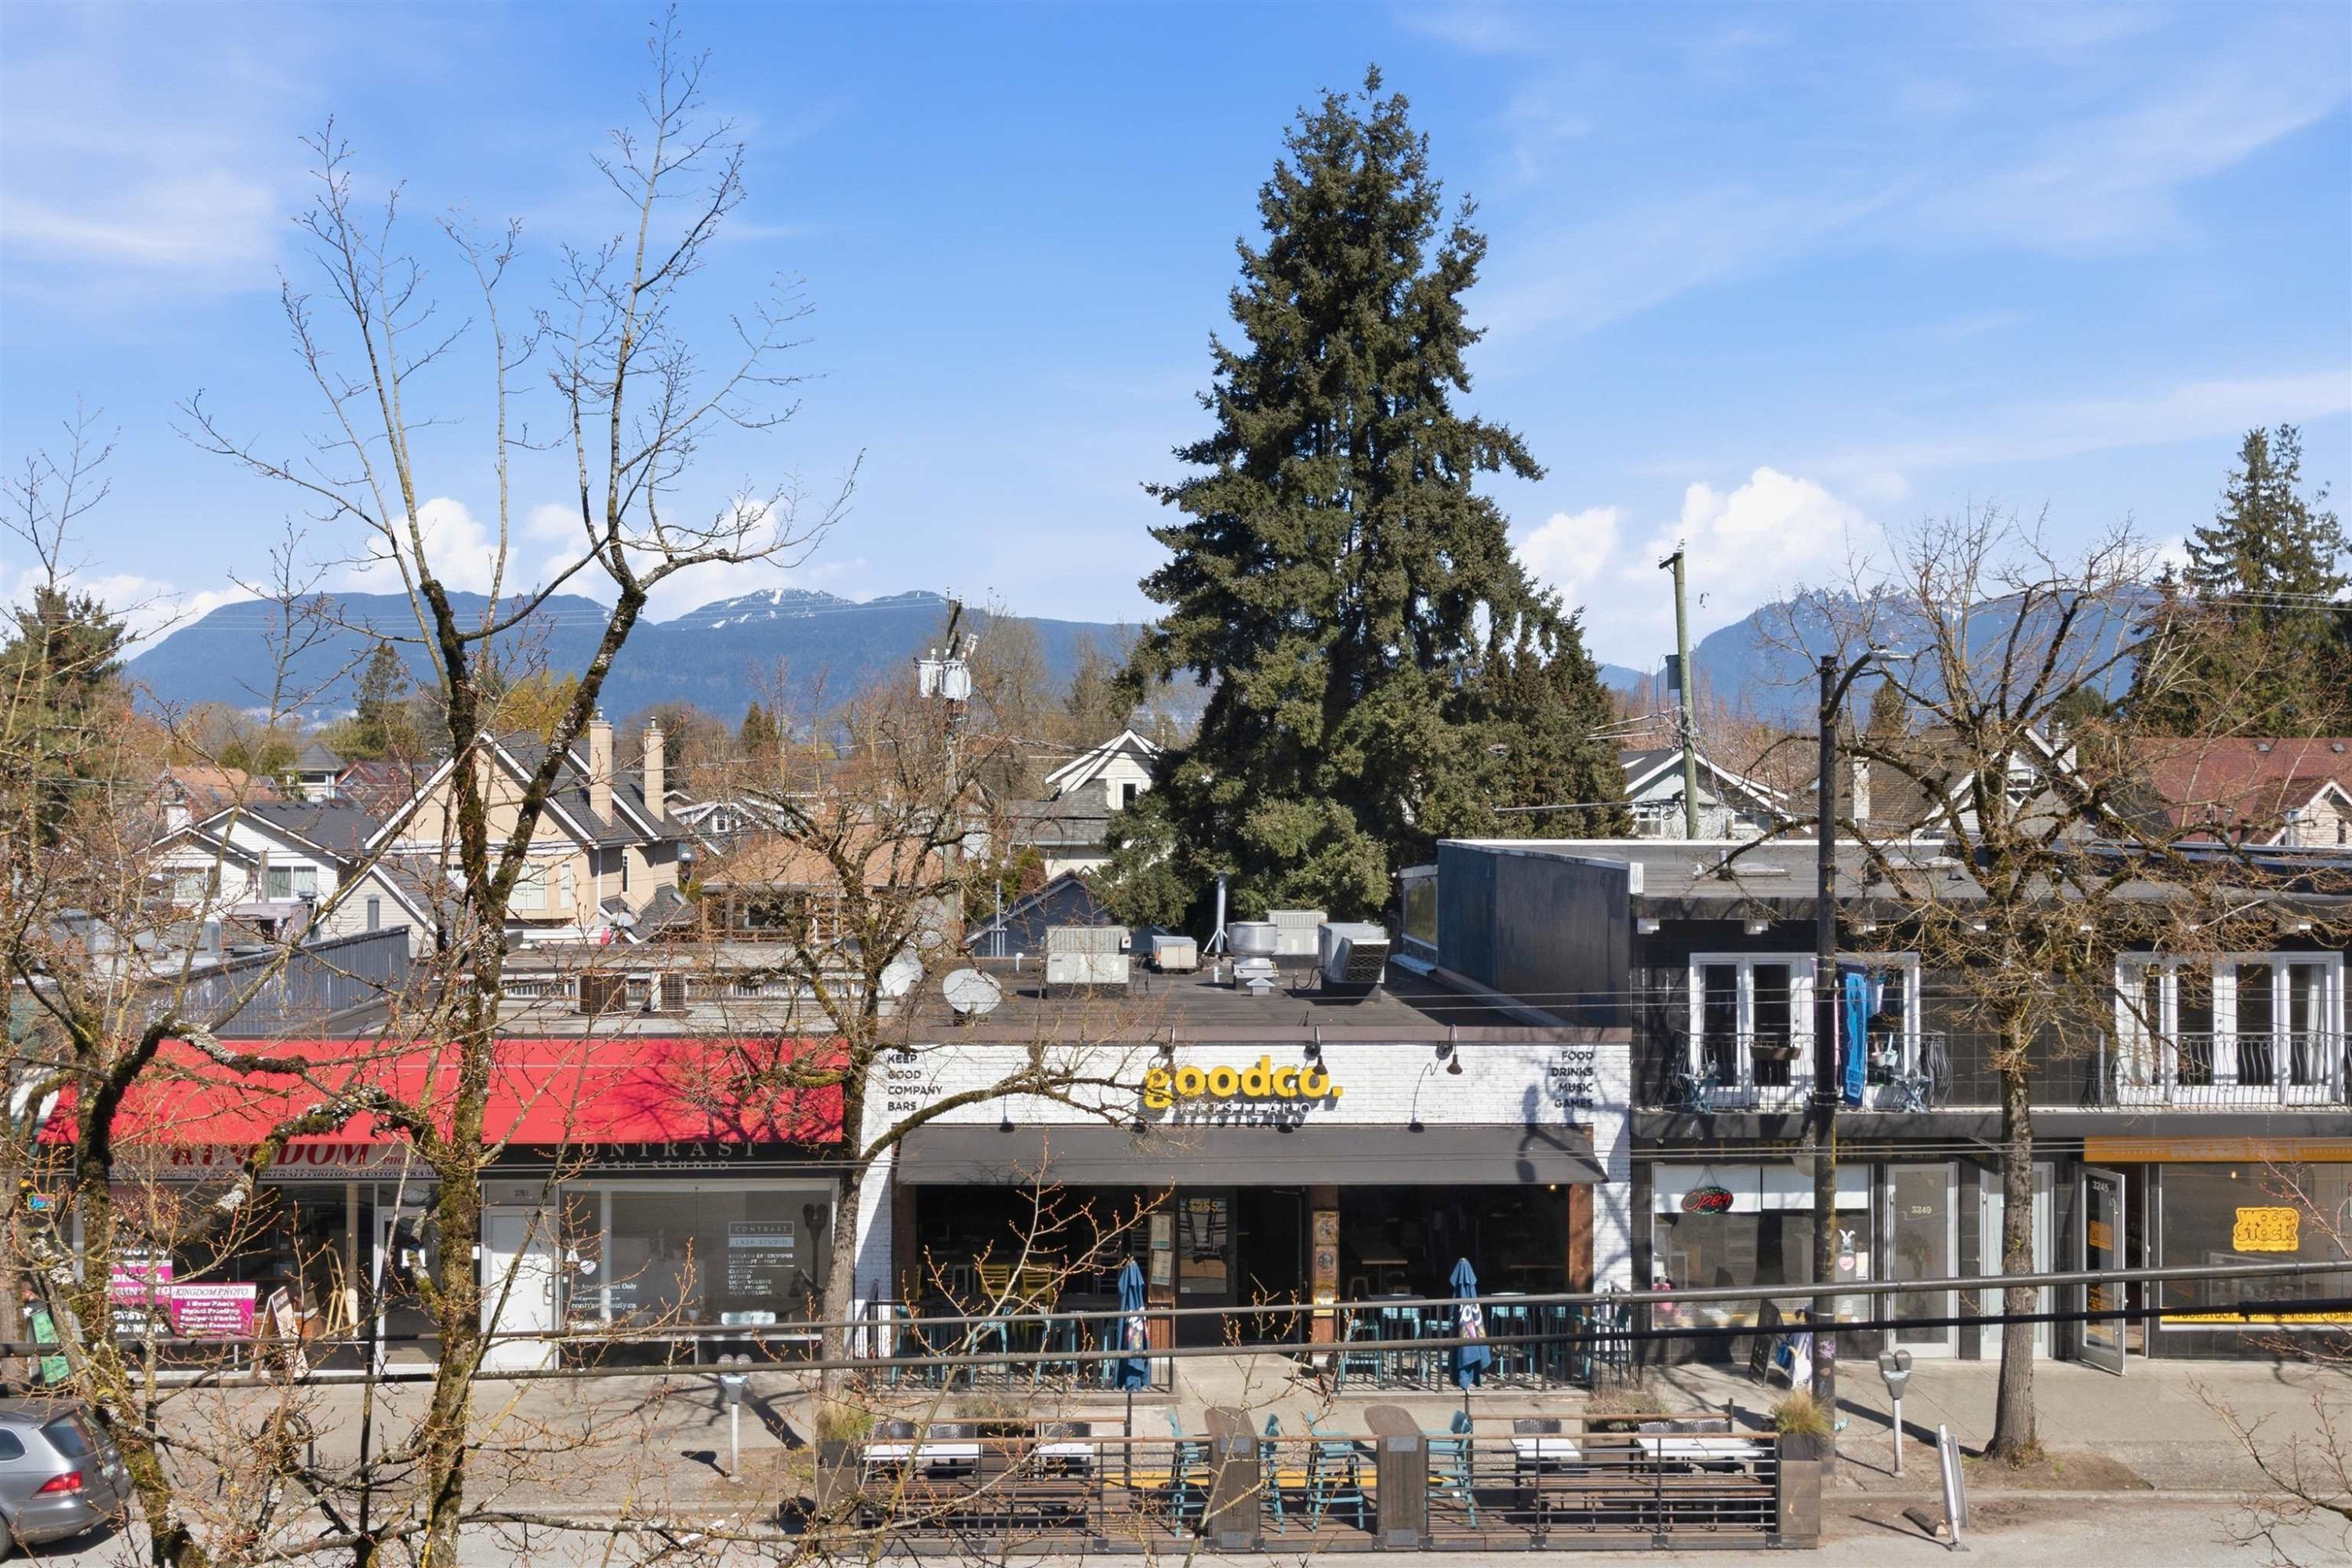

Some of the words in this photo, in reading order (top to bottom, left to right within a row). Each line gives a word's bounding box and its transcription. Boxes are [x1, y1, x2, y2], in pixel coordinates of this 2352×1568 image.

[887, 1054, 917, 1064] KEEP
[1562, 1051, 1594, 1061] FOOD
[887, 1070, 921, 1080] GOOD
[1551, 1067, 1593, 1076] DRINKS
[887, 1086, 942, 1095] COMPANY
[1559, 1083, 1593, 1092] MUSIC
[887, 1102, 916, 1111] BARS
[1555, 1098, 1593, 1108] GAMES
[2092, 1180, 2110, 1192] 3245
[1683, 1192, 1732, 1211] Open
[174, 1287, 216, 1296] KINGDOM
[218, 1287, 249, 1296] PHOTO
